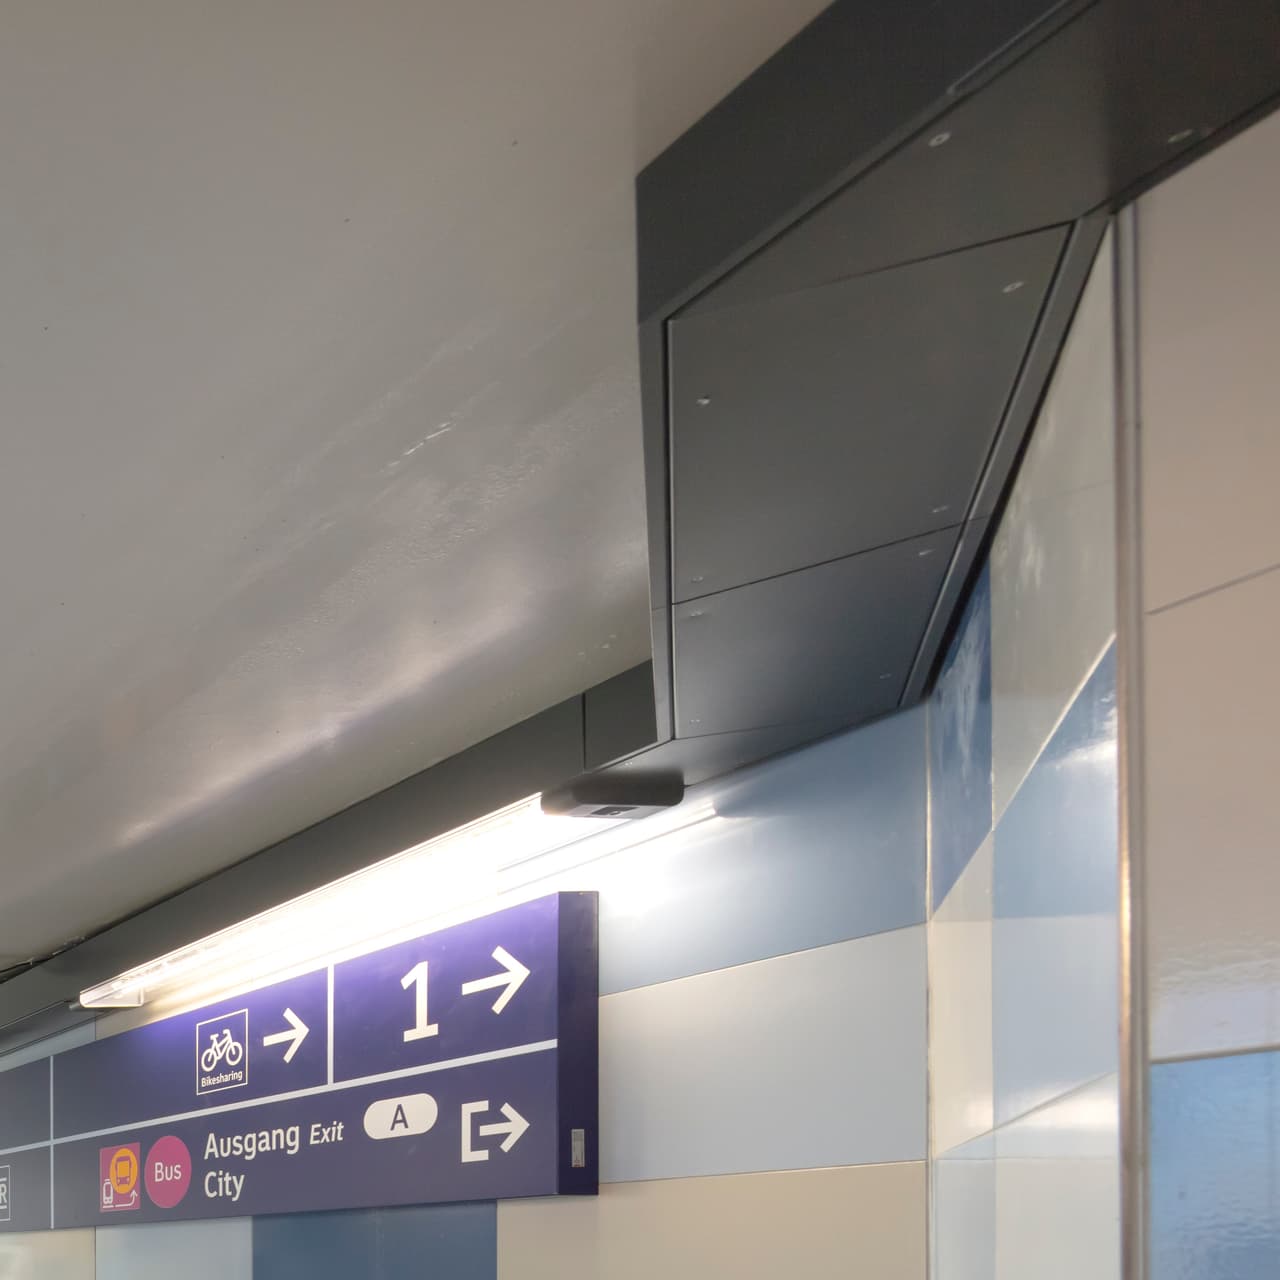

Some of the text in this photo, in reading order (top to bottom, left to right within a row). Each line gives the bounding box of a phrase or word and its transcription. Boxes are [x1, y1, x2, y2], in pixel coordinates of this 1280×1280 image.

[400, 960, 439, 1042] 1
[201, 1070, 243, 1087] Bikesharing
[204, 1103, 409, 1160] Ausgang Exit A
[154, 1161, 182, 1182] Bus
[204, 1170, 245, 1201] City
